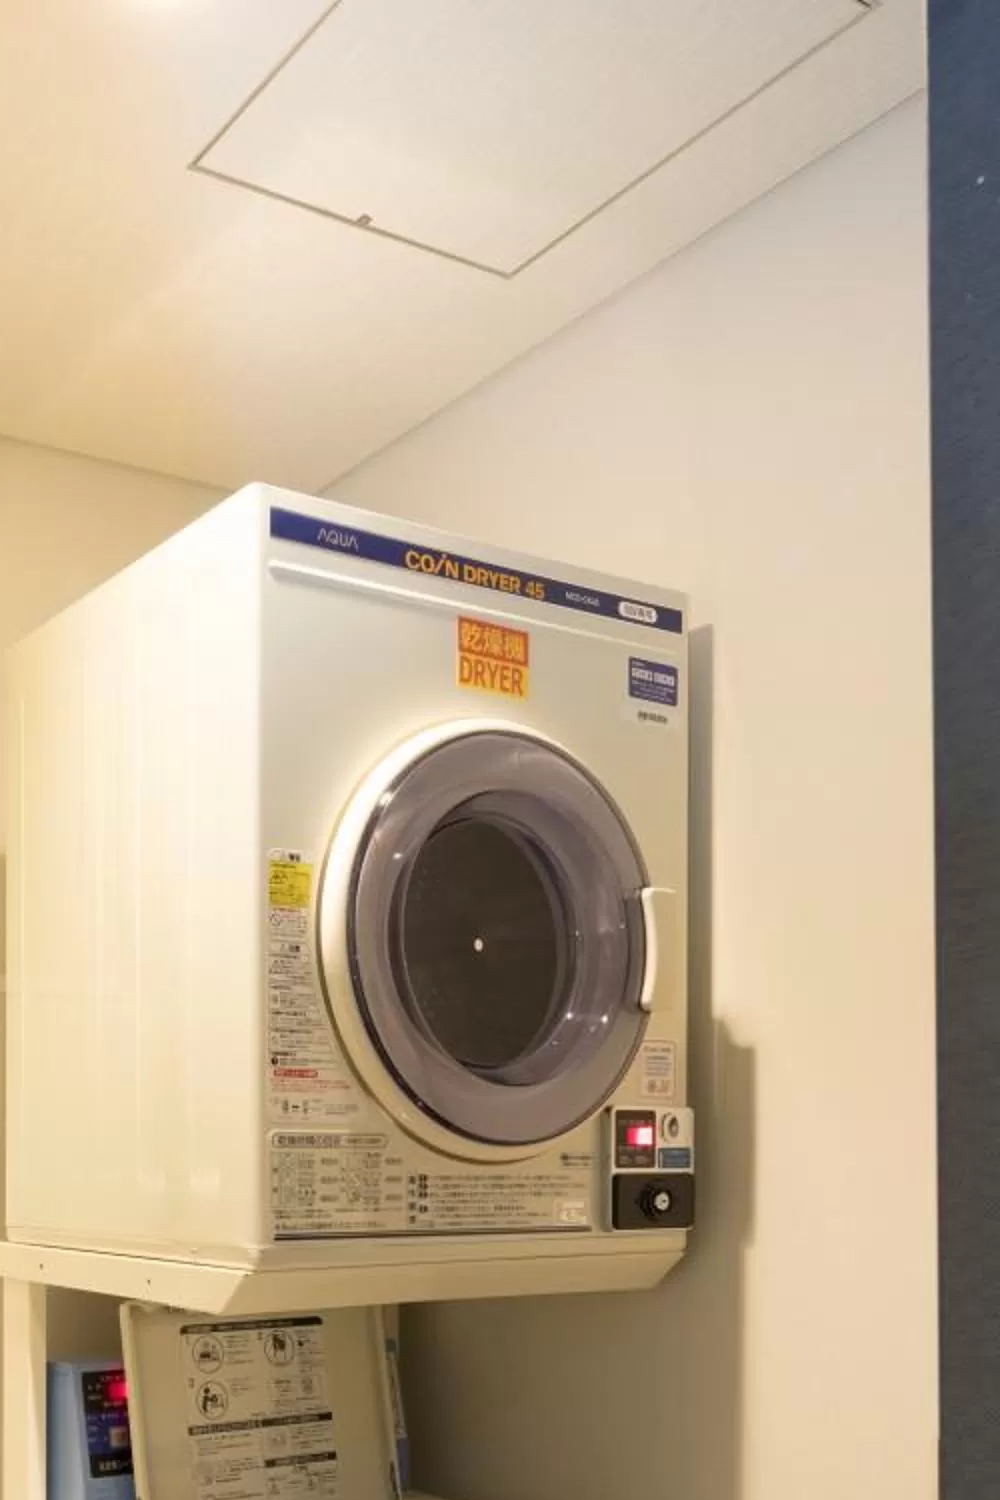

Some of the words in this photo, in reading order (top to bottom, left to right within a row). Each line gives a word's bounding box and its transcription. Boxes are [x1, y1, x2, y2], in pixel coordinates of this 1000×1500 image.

[316, 526, 360, 552] AQUA
[462, 563, 523, 596] DRYER
[525, 581, 546, 602] 45
[458, 654, 525, 698] DRYER
